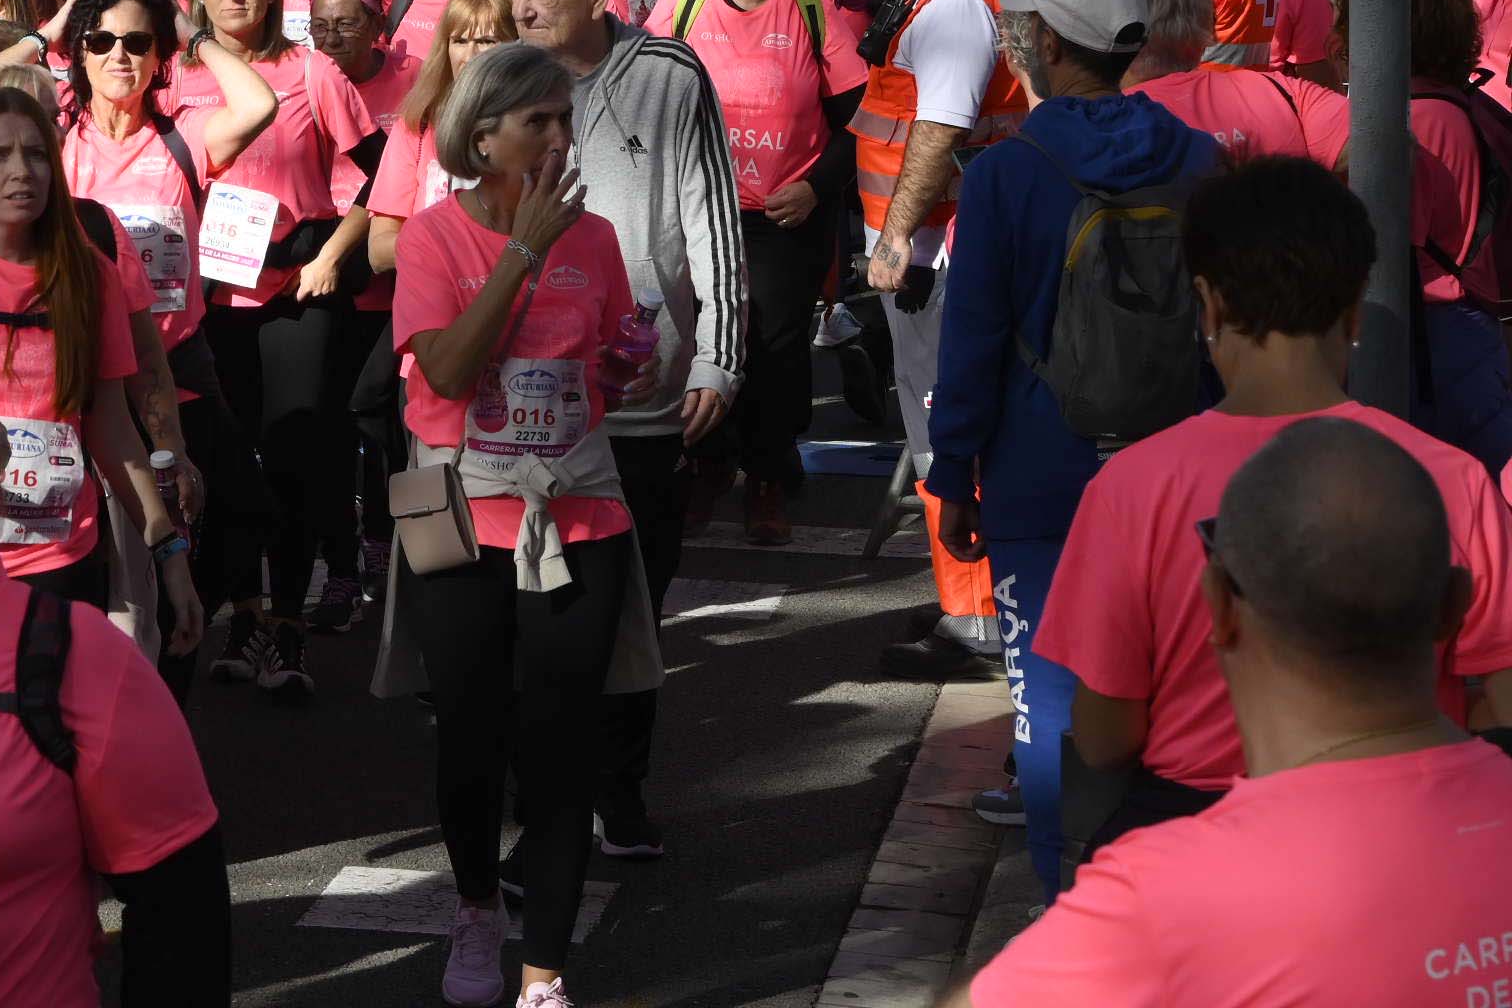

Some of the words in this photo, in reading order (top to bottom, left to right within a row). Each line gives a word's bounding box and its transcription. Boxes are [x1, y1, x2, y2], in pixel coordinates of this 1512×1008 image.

[512, 408, 556, 426] 016
[515, 430, 550, 442] 22730
[479, 443, 516, 454] CARRERA
[993, 573, 1031, 744] BARÇA
